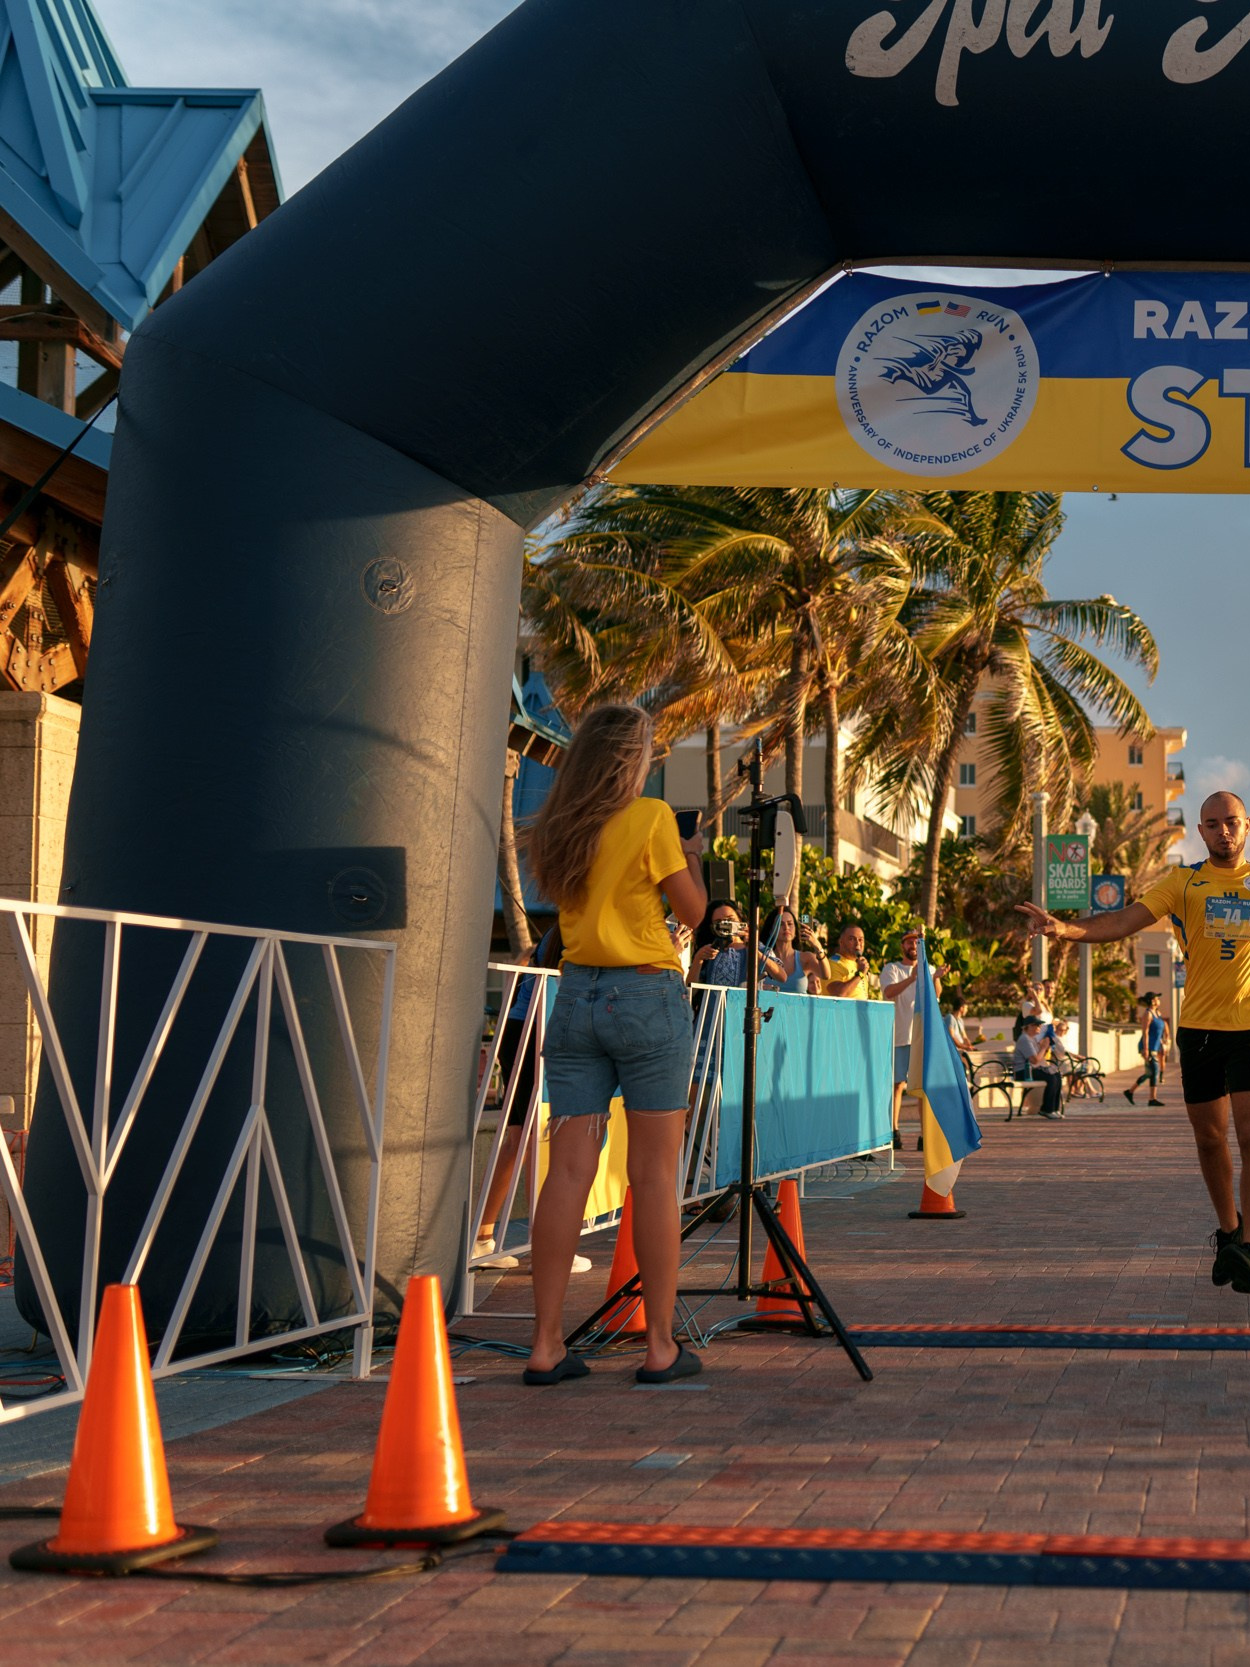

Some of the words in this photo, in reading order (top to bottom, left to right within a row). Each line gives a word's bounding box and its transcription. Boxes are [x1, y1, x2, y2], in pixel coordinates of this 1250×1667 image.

[856, 306, 909, 353] RAZOM
[976, 310, 1010, 334] RUN
[1013, 345, 1027, 368] RUN
[1018, 371, 1027, 384] 5K
[848, 365, 878, 439] ANNIVERSARY
[997, 386, 1027, 433] UKRAINE
[877, 437, 893, 450] OF
[983, 432, 997, 447] OF
[893, 443, 982, 464] INDEPENDENCE
[1049, 863, 1087, 878] SKATE
[1049, 878, 1087, 889] BOARDS
[1223, 908, 1242, 927] 74
